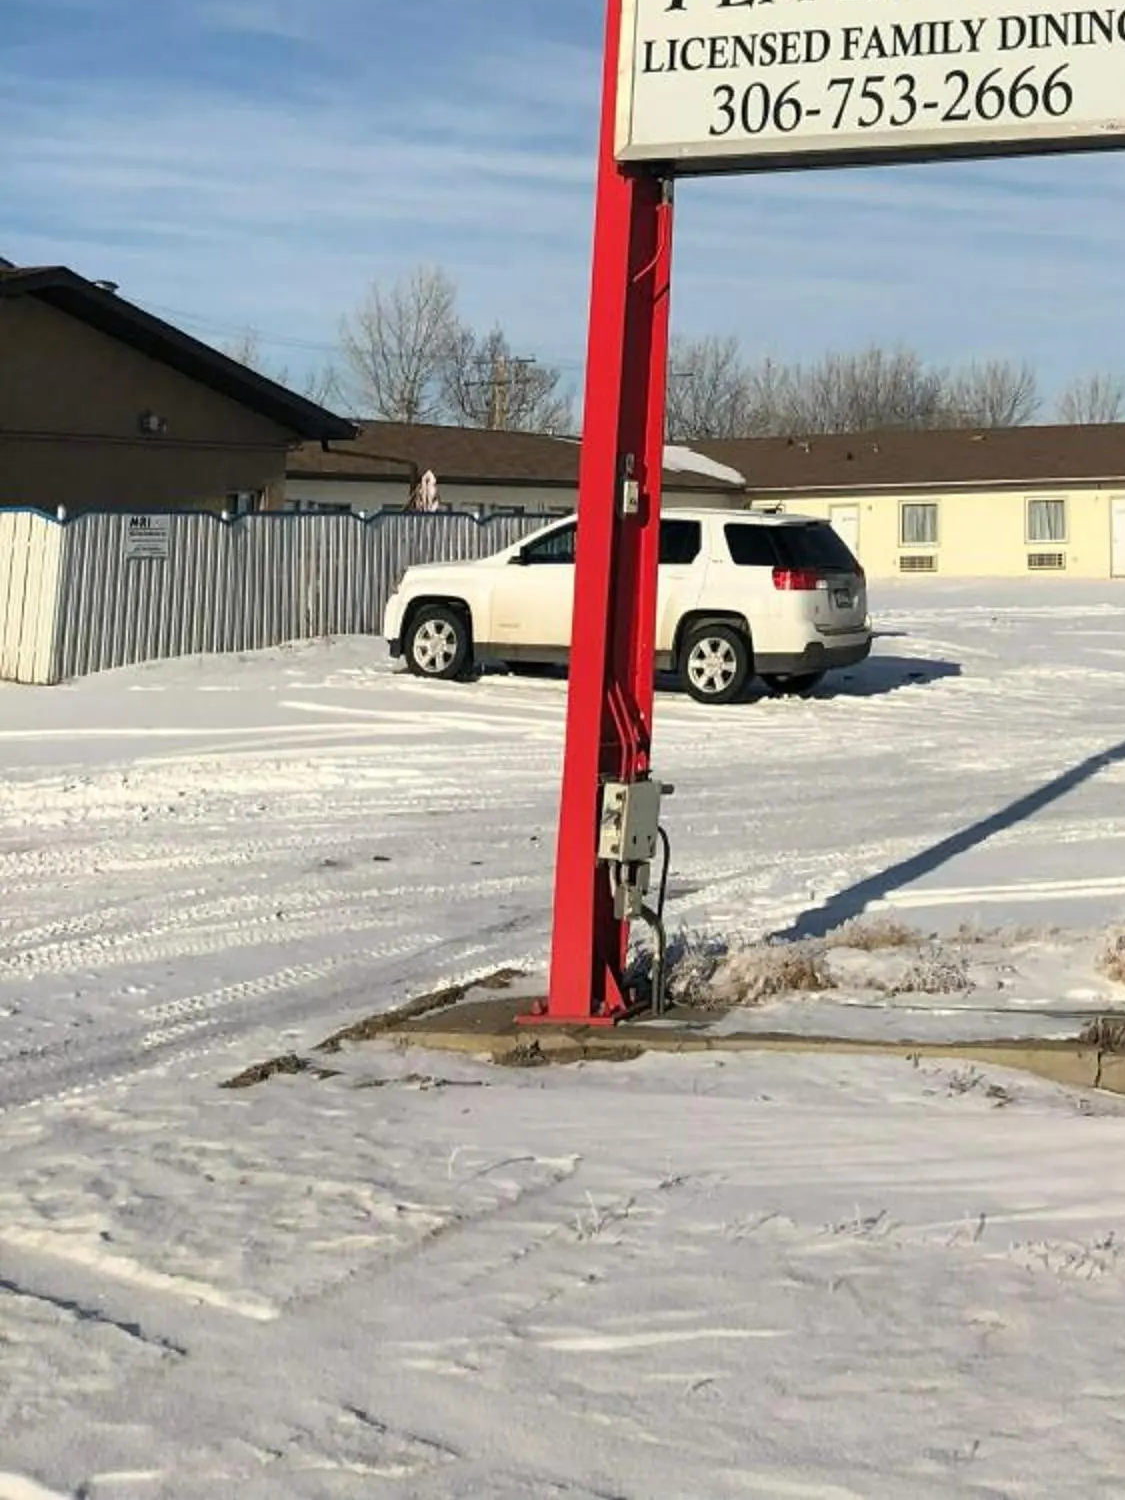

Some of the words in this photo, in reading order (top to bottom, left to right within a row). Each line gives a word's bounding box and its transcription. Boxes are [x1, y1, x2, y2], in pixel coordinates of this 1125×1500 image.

[642, 29, 831, 73] LICENSED
[842, 18, 988, 61] FAMILY
[708, 63, 1074, 136] 306-753-2666
